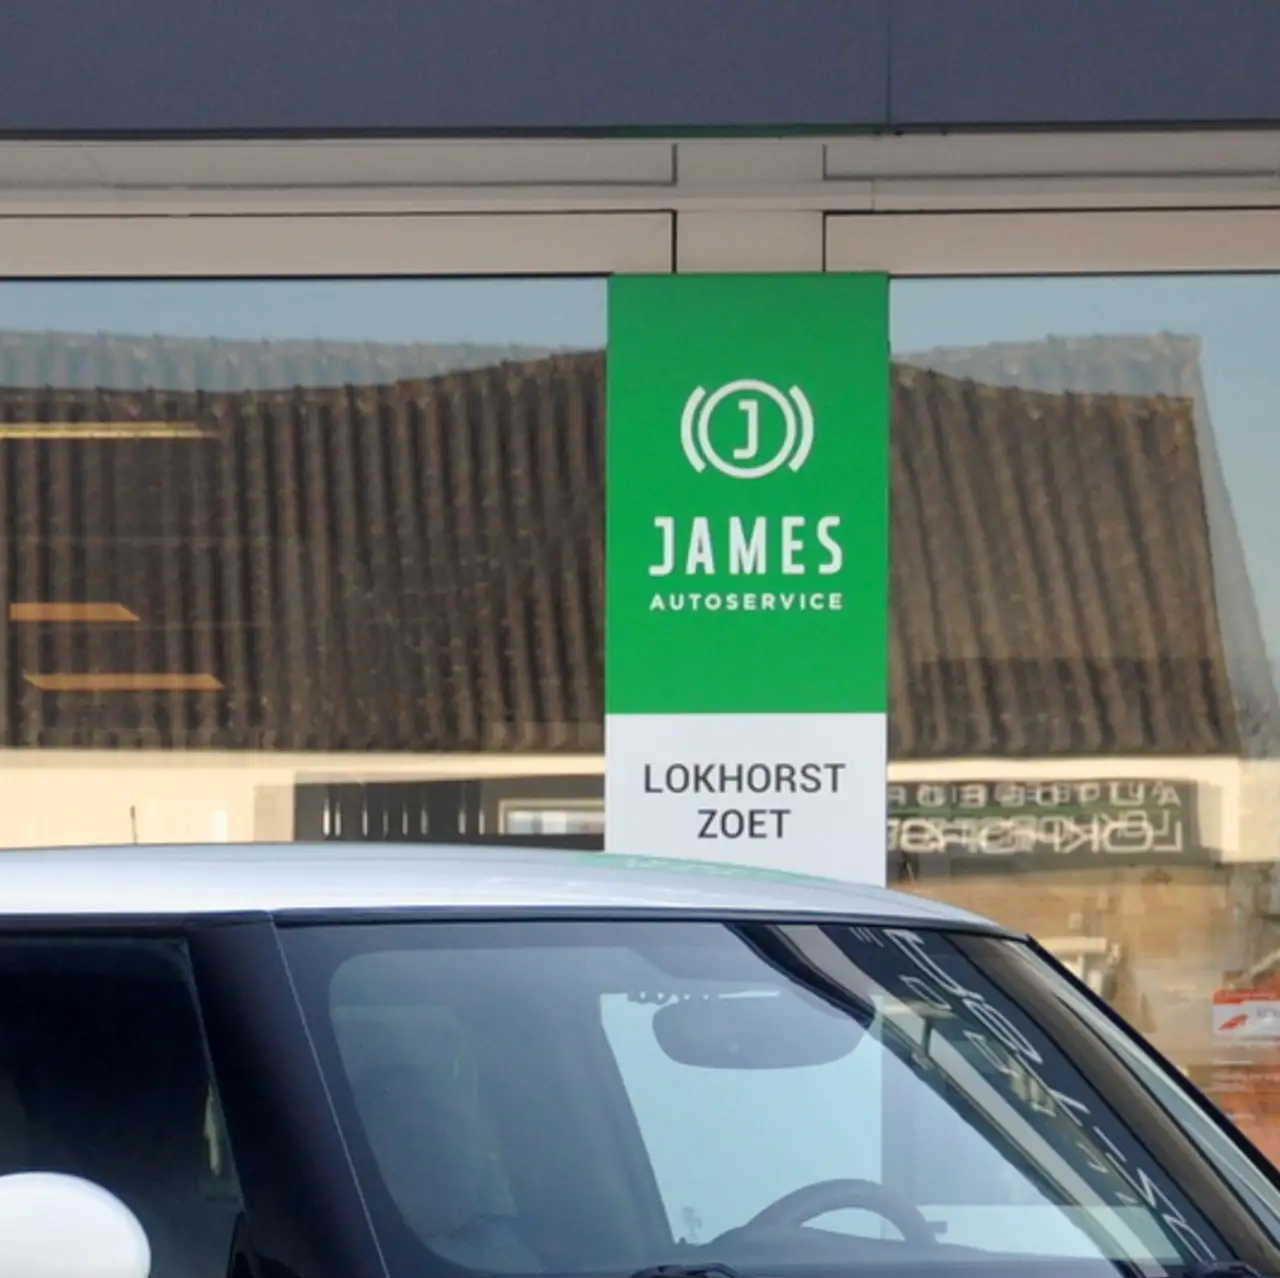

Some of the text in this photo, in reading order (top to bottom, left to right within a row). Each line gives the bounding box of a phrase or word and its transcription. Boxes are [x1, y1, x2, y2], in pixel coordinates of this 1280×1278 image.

[648, 515, 844, 577] JAMES
[649, 592, 844, 611] AUTOSERVICE
[643, 762, 847, 794] LOKHORST
[697, 808, 792, 839] ZOET
